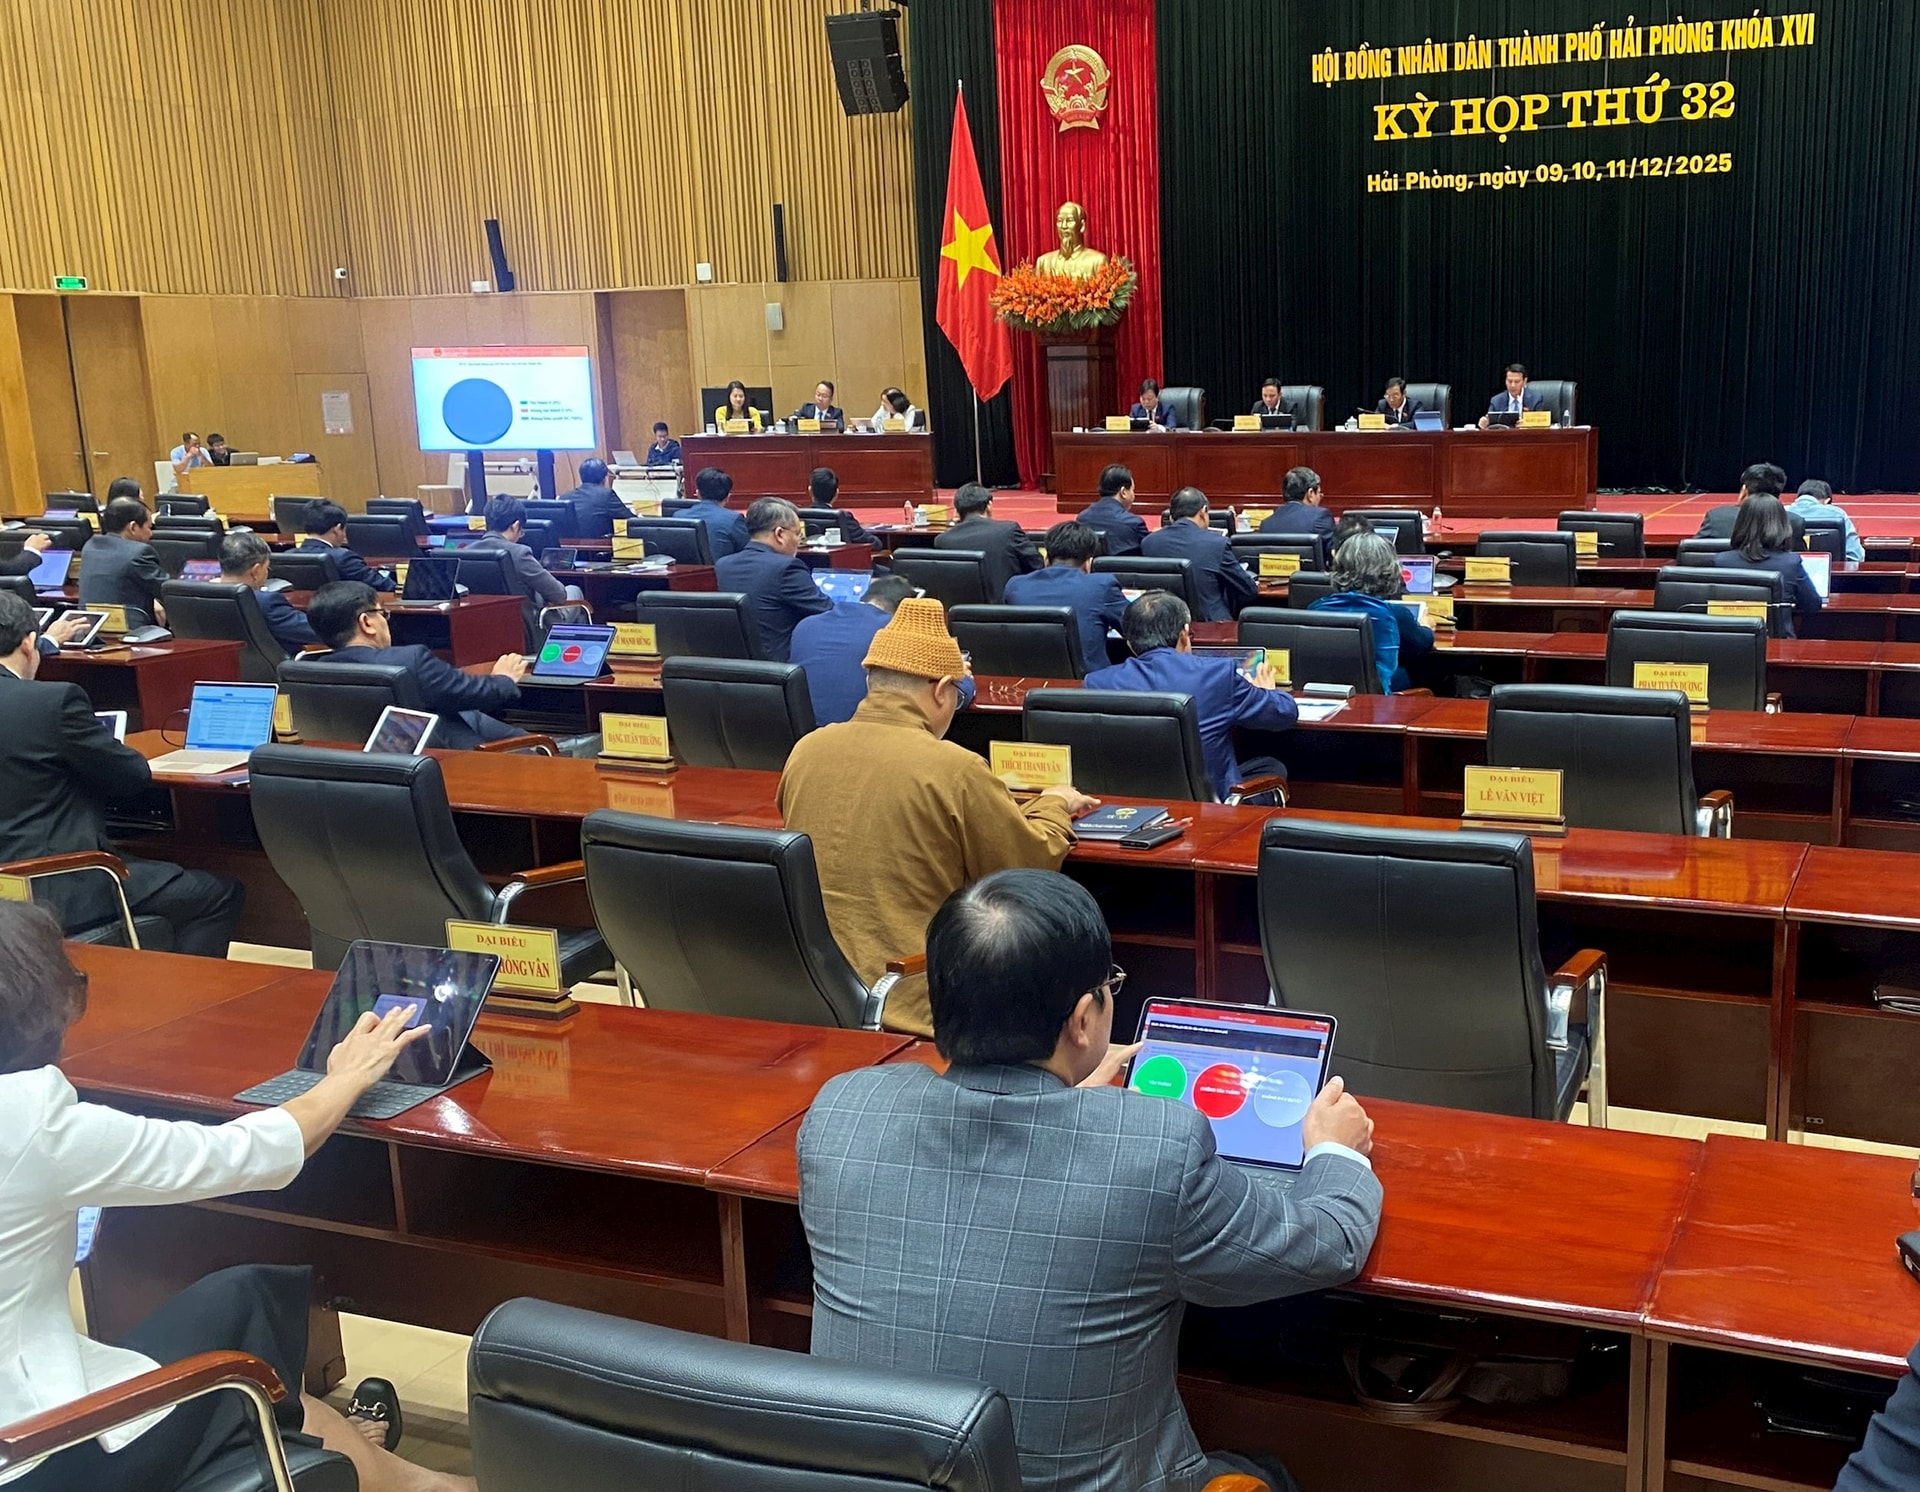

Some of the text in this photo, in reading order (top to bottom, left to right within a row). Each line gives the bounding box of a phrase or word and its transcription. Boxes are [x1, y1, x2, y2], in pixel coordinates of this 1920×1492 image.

[1312, 9, 1815, 88] HỘI ĐỒNG NHÂN DÂN THÀNH PHỐ HẢI PHÒNG KHÓA XVI
[1373, 71, 1735, 143] KỲ HỌP THỨ 32
[1367, 169, 1399, 193] Hải
[1405, 169, 1474, 192] Phòng,
[1479, 165, 1530, 190] ngày
[1480, 787, 1493, 801] LÊ
[1519, 791, 1545, 806] VIỆT
[476, 934, 496, 946] ĐẠI
